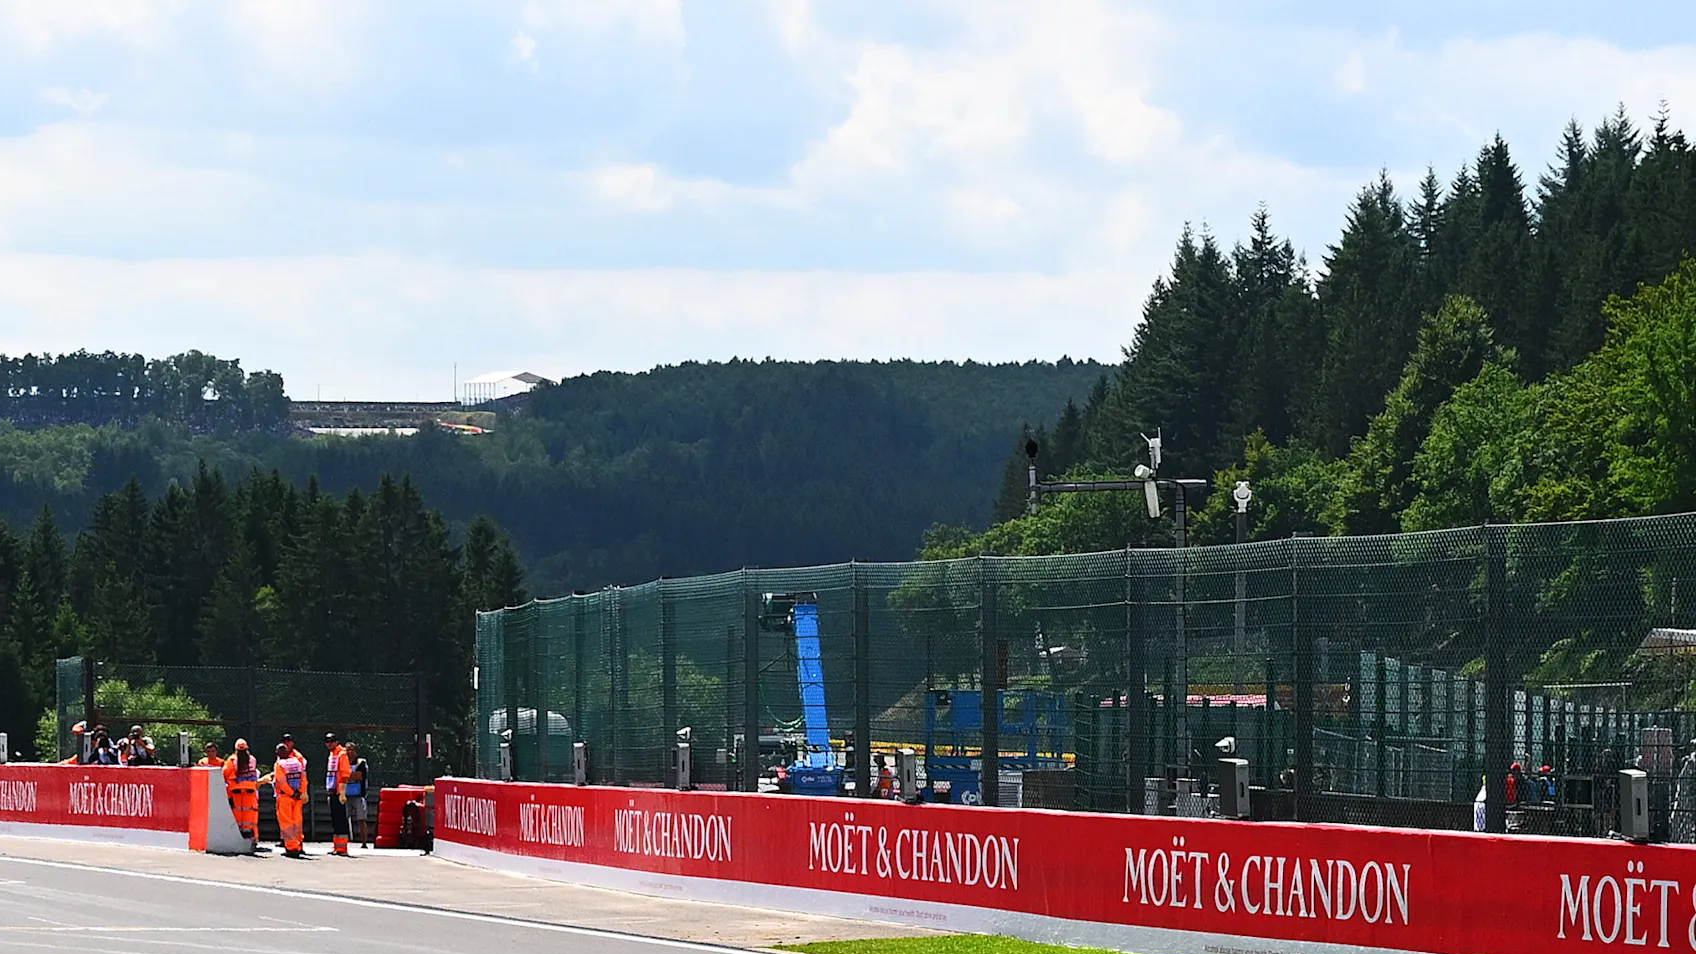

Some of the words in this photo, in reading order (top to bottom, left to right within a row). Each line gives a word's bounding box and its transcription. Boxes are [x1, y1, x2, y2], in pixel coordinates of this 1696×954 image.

[68, 775, 96, 815] MOËT
[96, 783, 104, 815] &
[104, 783, 154, 818] CHANDON
[444, 786, 461, 831] MOËT
[466, 797, 496, 837] CHANDON
[519, 794, 540, 842] MOËT
[540, 804, 547, 844] &
[547, 805, 585, 848] CHANDON
[614, 799, 642, 853] MOËT
[643, 810, 653, 857] &
[653, 812, 732, 862] CHANDON
[808, 812, 873, 875] MOËT
[876, 826, 892, 879] &
[896, 829, 1020, 891] CHANDON
[1122, 836, 1210, 910] MOËT
[1215, 852, 1236, 913] &
[1241, 855, 1411, 926] CHANDON
[1557, 860, 1680, 948] MOËT
